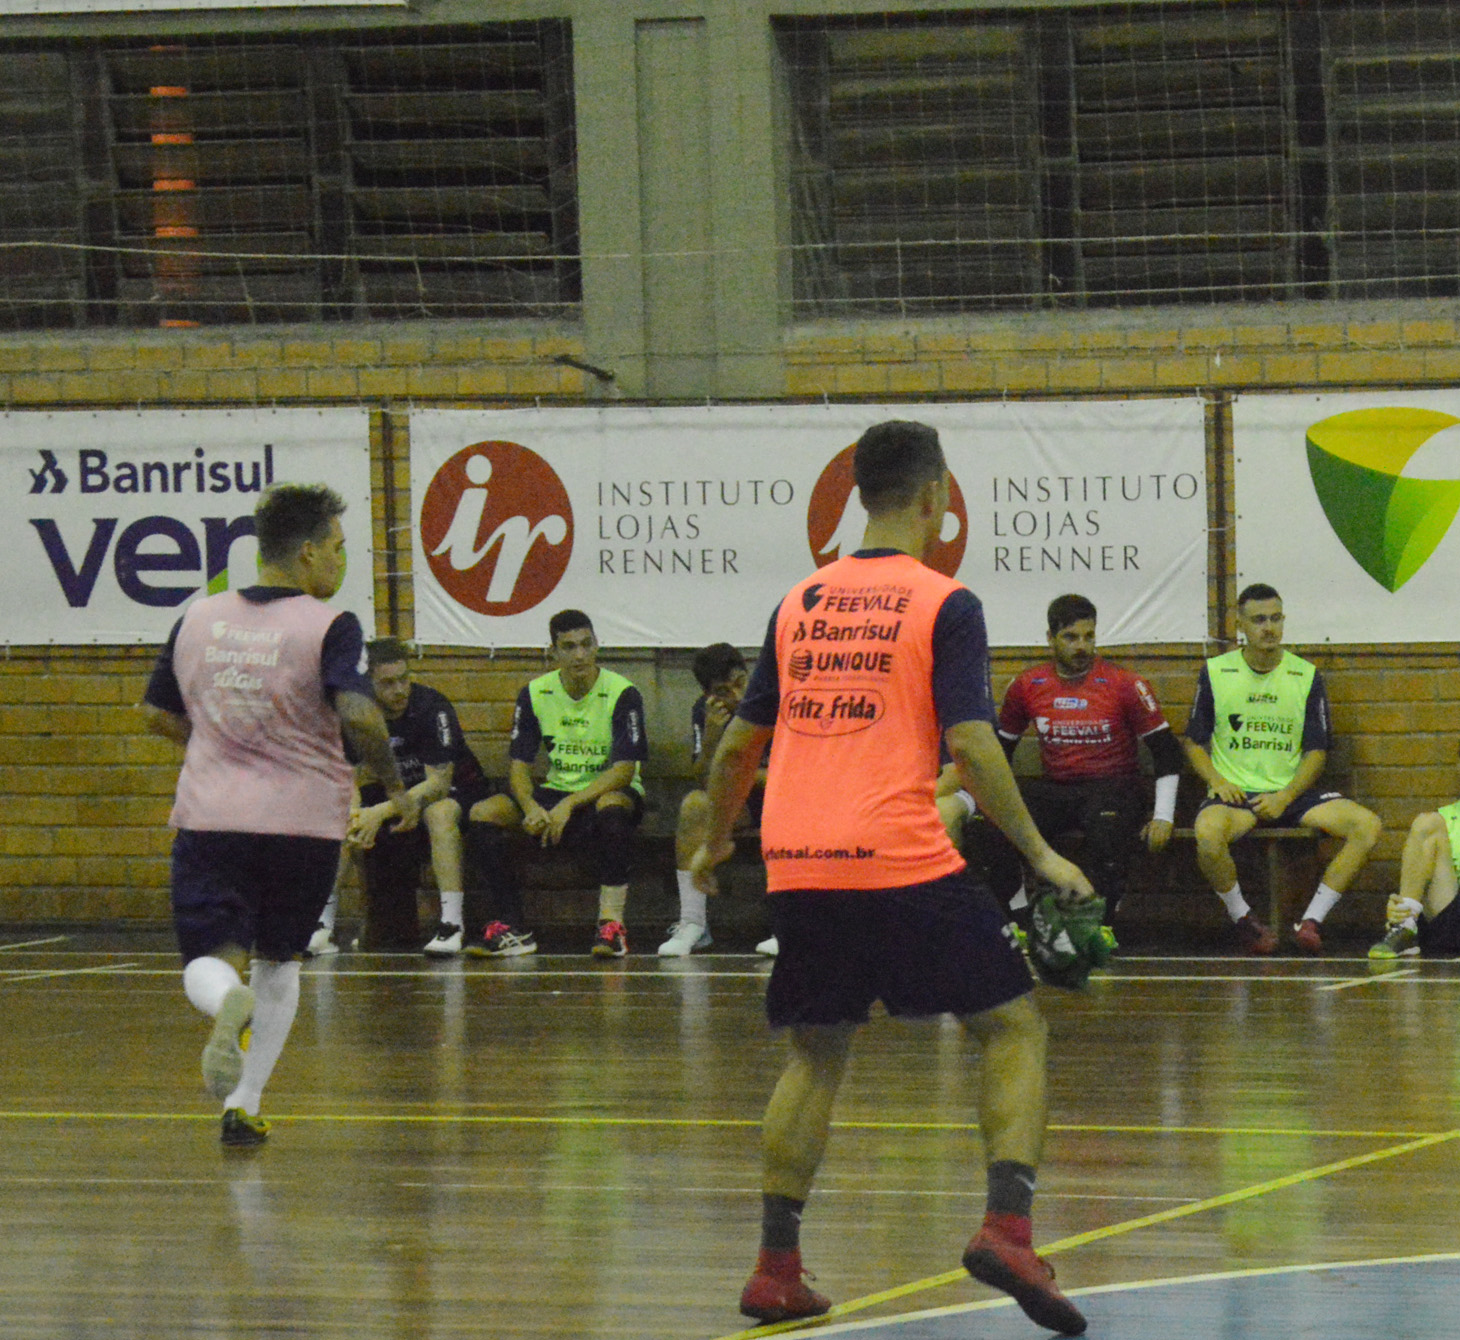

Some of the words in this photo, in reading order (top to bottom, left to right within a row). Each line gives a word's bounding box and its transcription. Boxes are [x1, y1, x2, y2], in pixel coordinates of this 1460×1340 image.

[78, 444, 273, 493] Banrisul
[598, 480, 793, 506] INSTITUTO
[993, 473, 1198, 502] INSTITUTO
[599, 514, 699, 543] LOJAS
[994, 510, 1100, 540] LOJAS
[600, 549, 738, 574] RENNER
[995, 545, 1140, 571] RENNER
[824, 596, 910, 613] FEEVALE
[811, 619, 901, 642] Banrisul
[206, 646, 279, 666] Banrisul
[817, 652, 893, 673] UNIQUE
[1246, 721, 1294, 735] FEEVALE
[558, 743, 607, 756] FEEVALE
[555, 757, 603, 773] Banris
